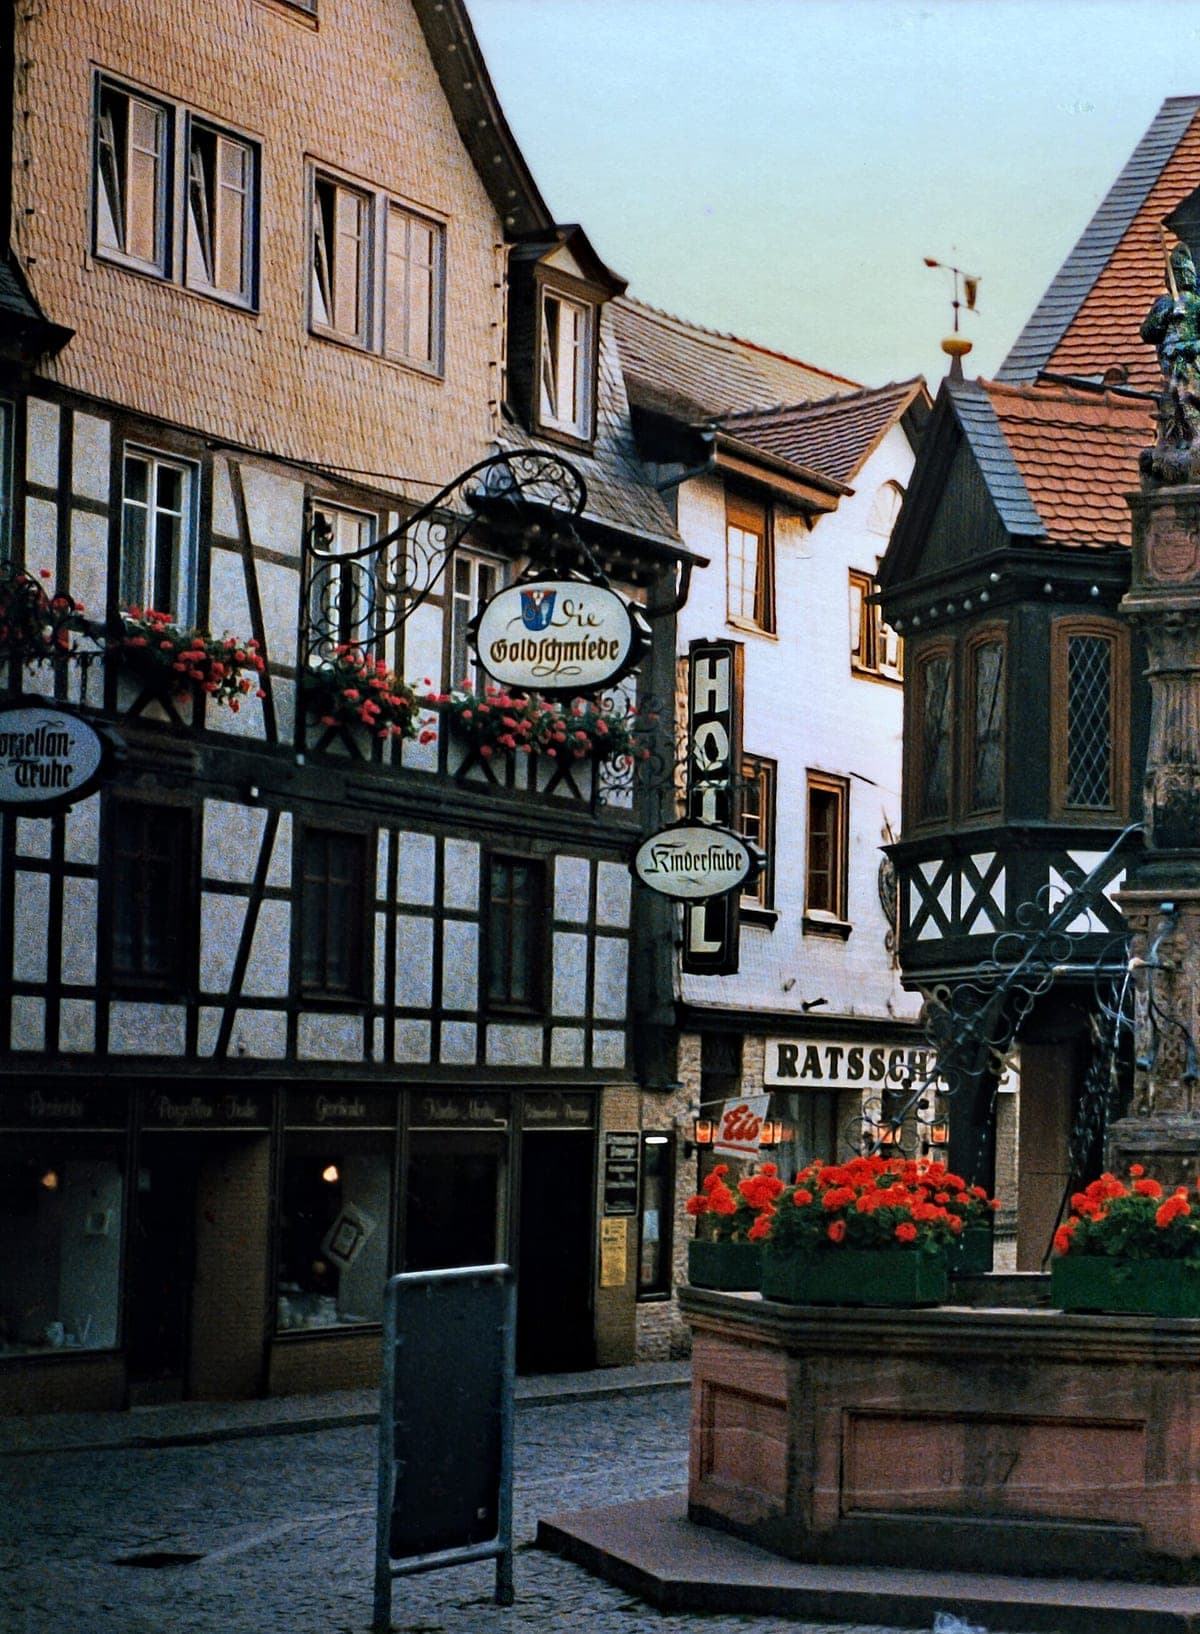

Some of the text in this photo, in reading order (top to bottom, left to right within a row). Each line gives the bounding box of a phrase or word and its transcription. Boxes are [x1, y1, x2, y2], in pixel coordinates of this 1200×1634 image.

[550, 599, 604, 628] Die
[0, 727, 75, 758] orzellan-
[9, 760, 73, 788] Truhe
[689, 657, 731, 953] HOTL
[723, 1104, 762, 1141] Eis
